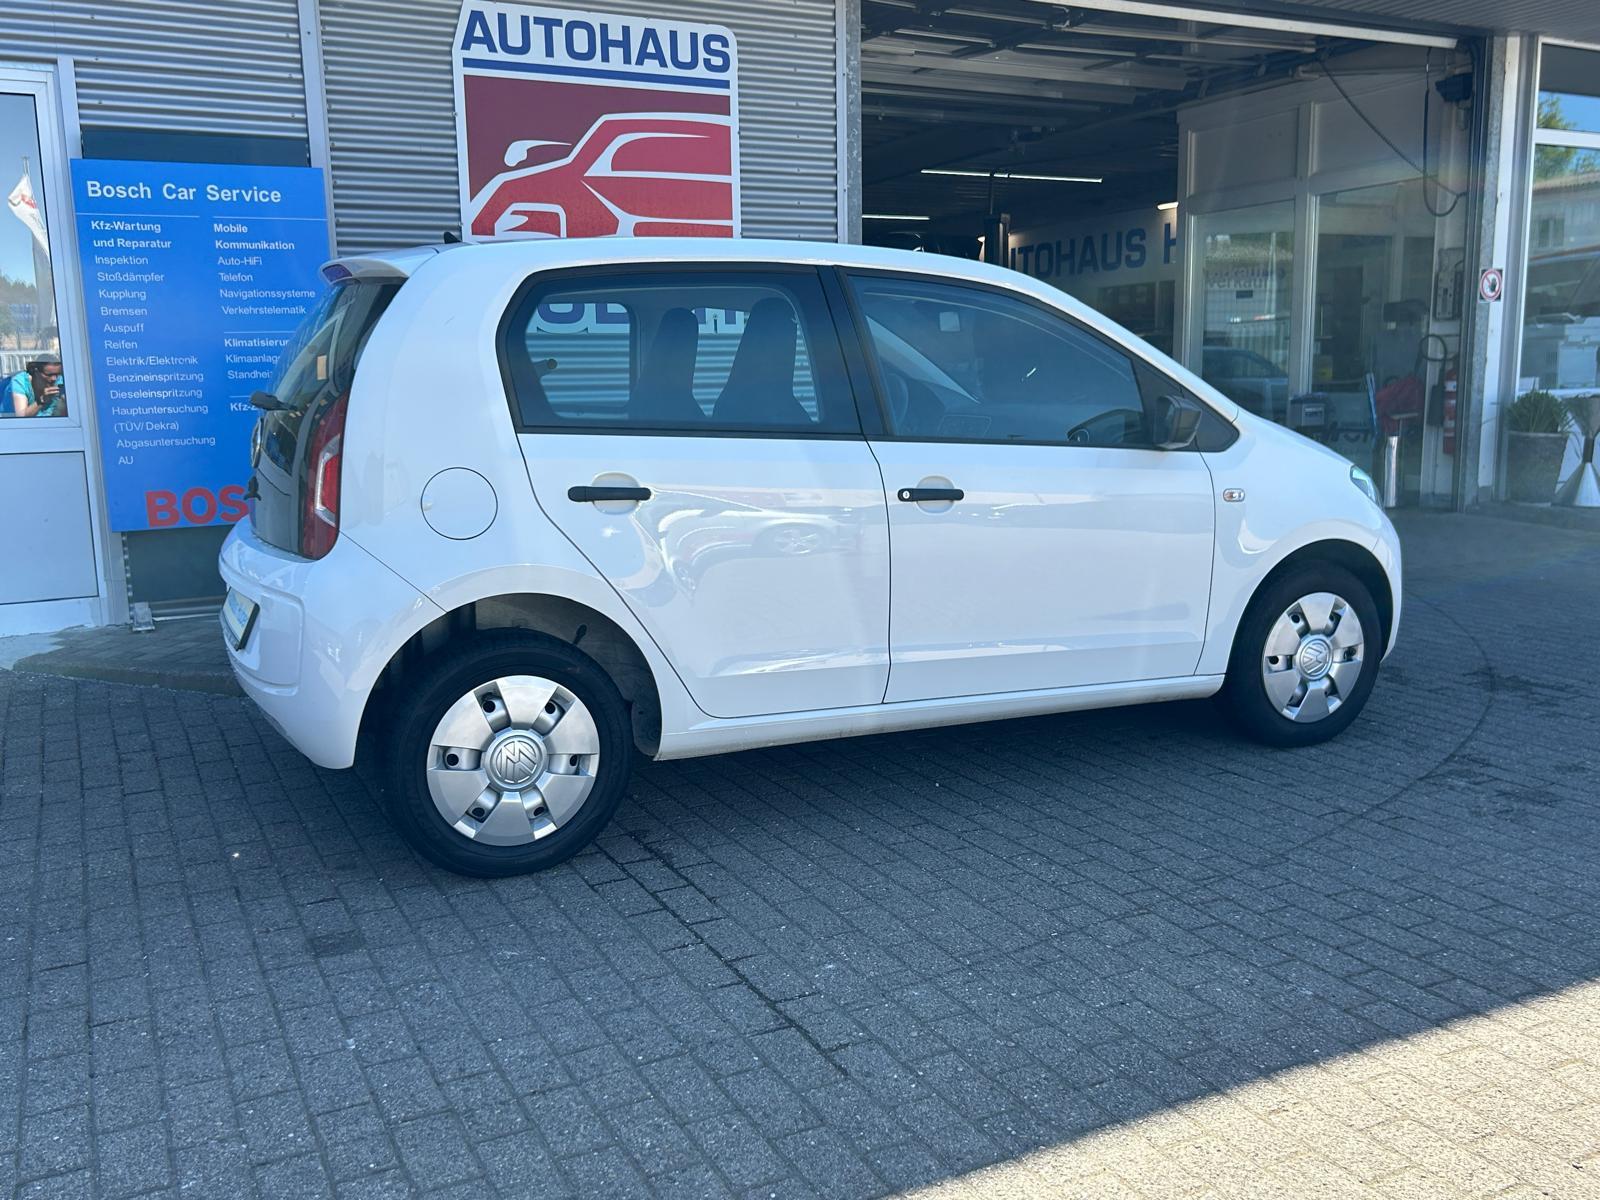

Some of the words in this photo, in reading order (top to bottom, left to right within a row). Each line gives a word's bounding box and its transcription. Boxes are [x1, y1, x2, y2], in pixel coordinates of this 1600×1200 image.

[460, 9, 731, 74] AUTOHAUS
[86, 180, 152, 199] Bosch
[162, 183, 197, 200] Car
[206, 184, 282, 203] Service
[91, 220, 161, 234] Kfz-Wartung
[213, 223, 248, 233] Mobile
[93, 238, 115, 248] und
[117, 238, 172, 250] Reparatur
[215, 239, 295, 250] Kommunikation
[1010, 227, 1147, 278] TOHAUS
[95, 255, 149, 266] Inspektion
[217, 256, 262, 266] Auto-HiFi
[97, 272, 165, 283] Stoßdämpfer
[218, 272, 253, 282] Telefon
[98, 289, 147, 301] Kupplung
[219, 288, 316, 300] Navigationssysteme
[100, 306, 148, 316] Bremsen
[222, 305, 307, 315] Verkehrstelematik
[103, 323, 144, 333] Auspuff
[104, 340, 138, 350] Reifen
[106, 355, 199, 366] Elektrik/Elektronik
[108, 371, 204, 383] Benzineinspritzung
[227, 369, 273, 379] Standhei
[110, 388, 203, 399] Dieseleinspritzung
[111, 404, 209, 416] Hauptuntersuchung
[116, 435, 217, 449] Abgasuntersuchung
[118, 455, 134, 465] AU
[144, 484, 250, 528] BOS
